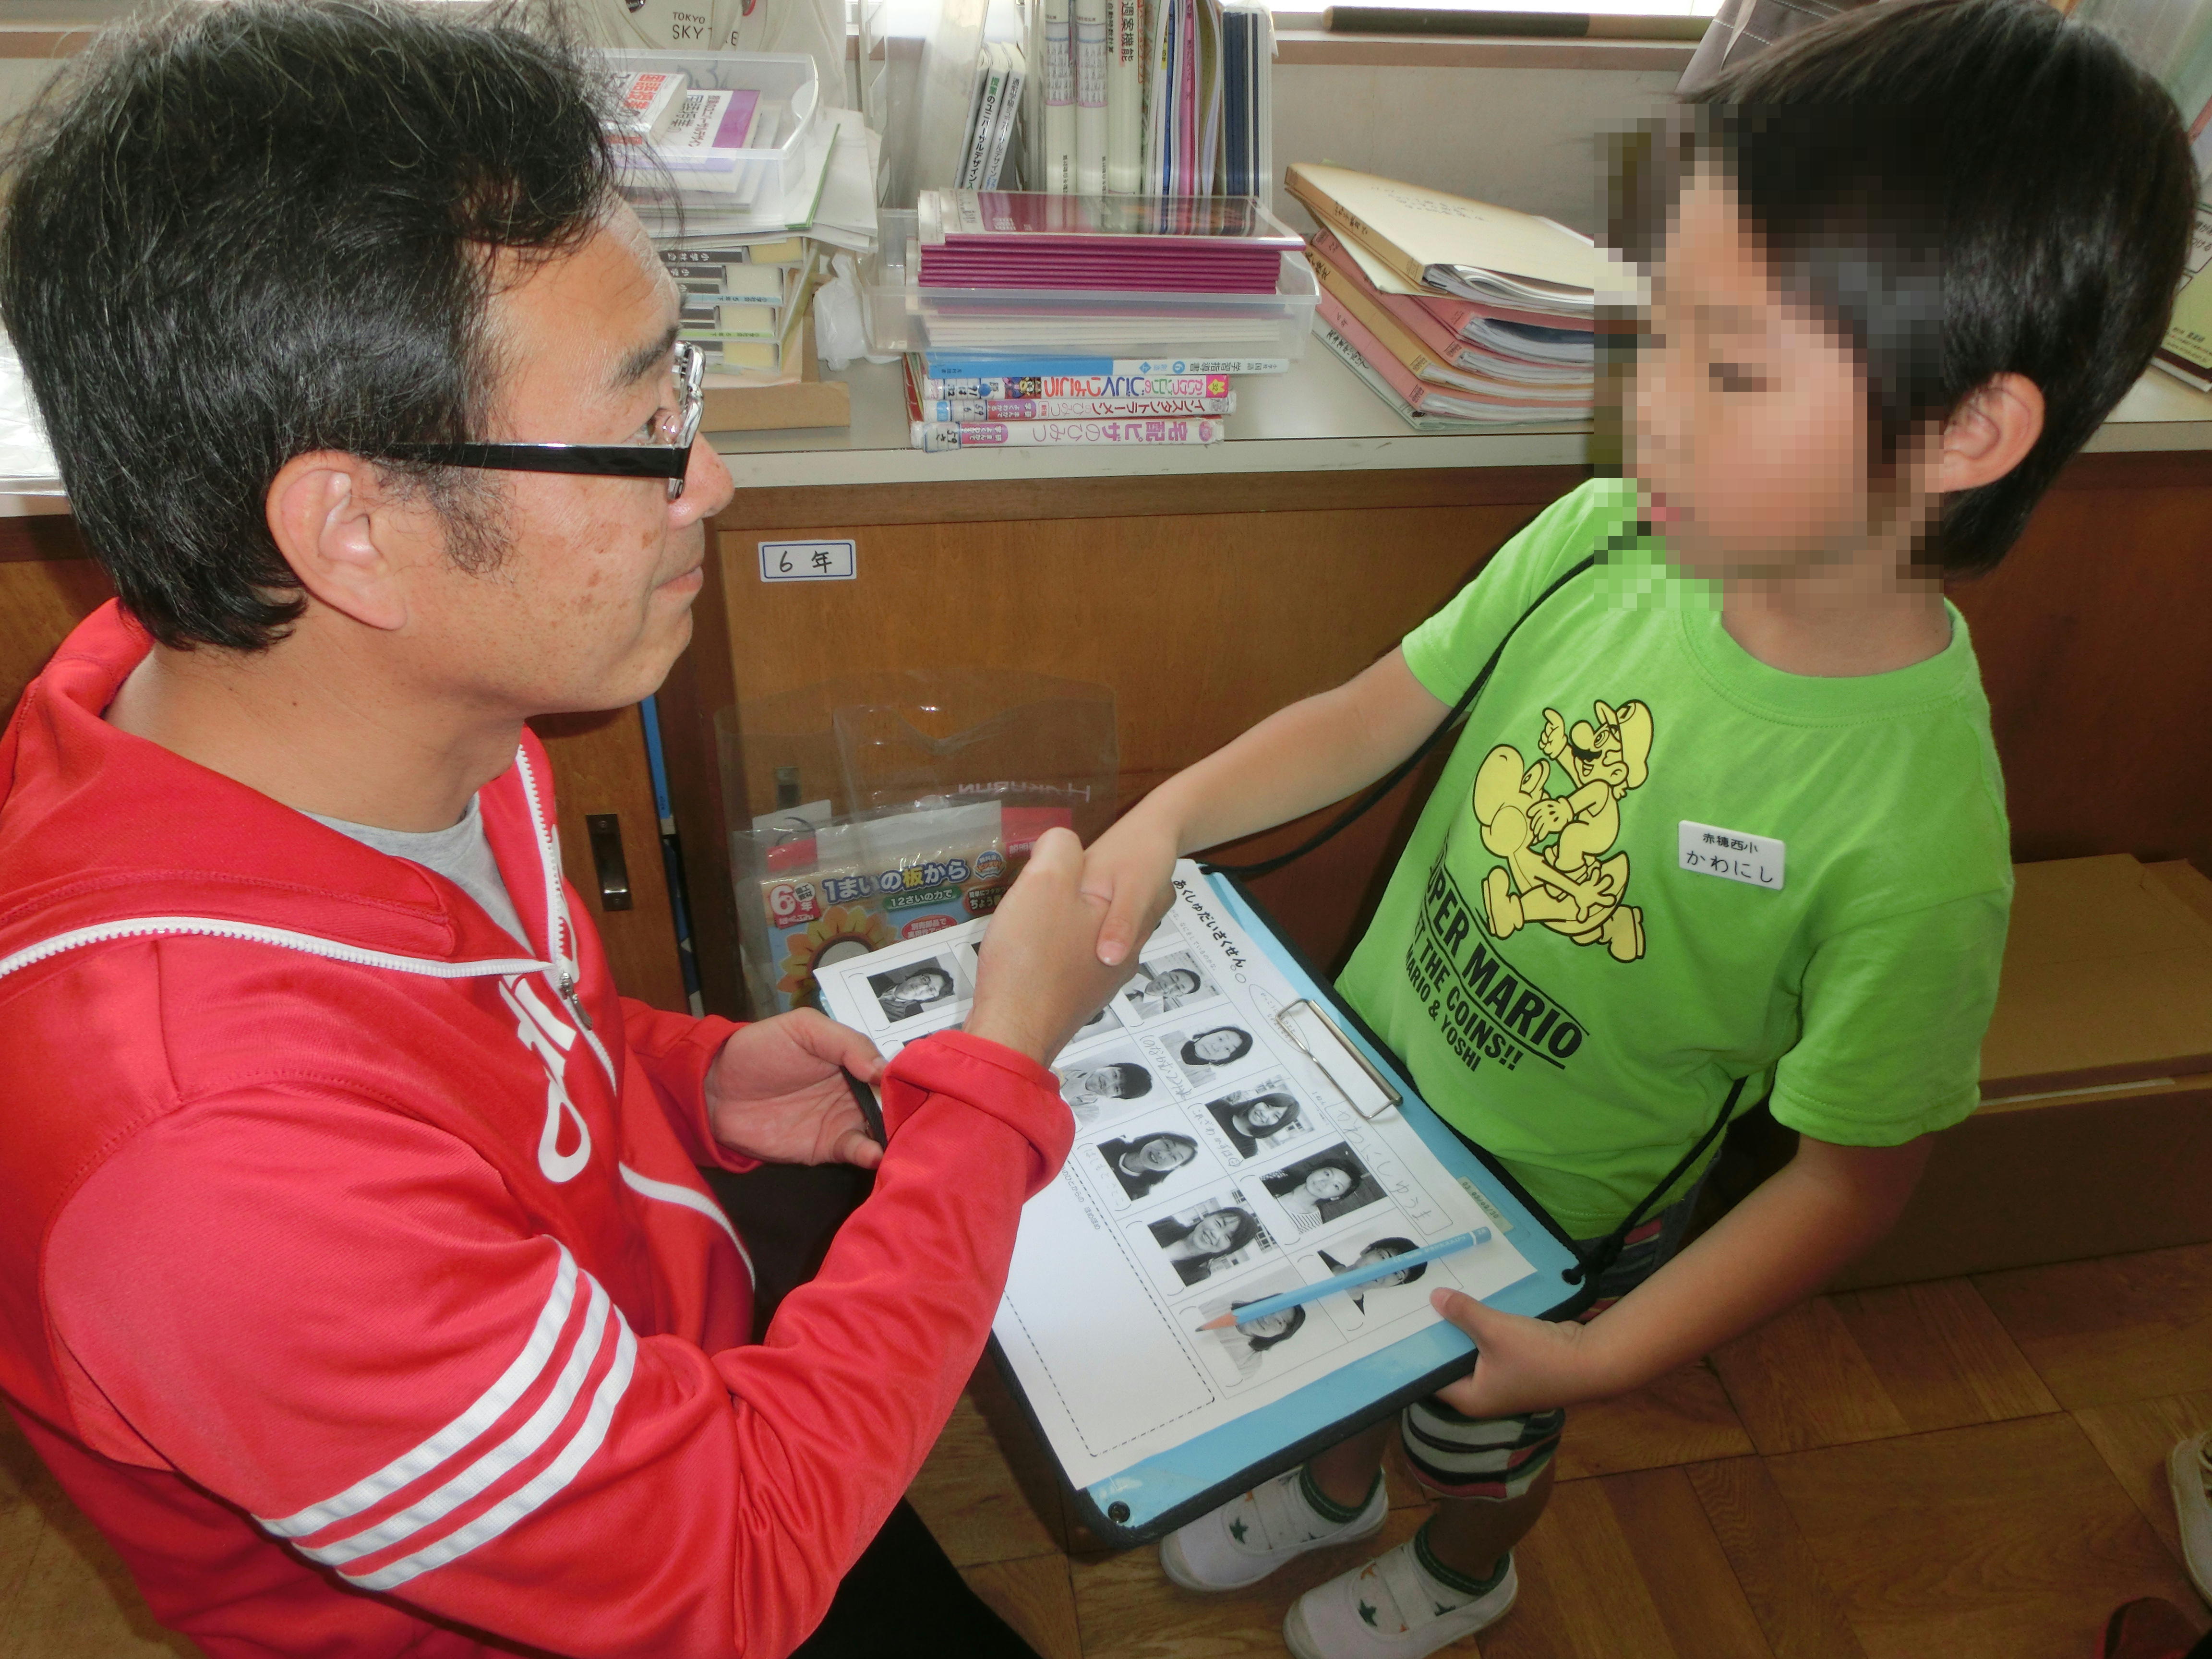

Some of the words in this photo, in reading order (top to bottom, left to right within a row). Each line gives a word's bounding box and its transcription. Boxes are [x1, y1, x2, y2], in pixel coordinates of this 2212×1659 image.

[673, 12, 705, 24] TOKYO
[673, 24, 704, 39] SKY
[1121, 2, 1134, 62] 週案機能
[1190, 361, 1241, 372] 学習指導書
[1212, 383, 1218, 391] 32
[1050, 400, 1205, 417] インスタントラーメンのひみつ
[1033, 421, 1188, 442] 宅配ピザのひみつ
[780, 550, 793, 573] 6
[811, 550, 833, 574] 年
[1703, 833, 1758, 854] 赤穂西小
[1686, 850, 1773, 883] かわにし
[823, 860, 967, 902] 1まいの板から
[890, 889, 953, 907] 12さいの力で
[1173, 879, 1247, 968] あくしゅだいさくせん
[1419, 938, 1450, 993] THE
[1446, 986, 1524, 1070] COINS!!
[1462, 942, 1583, 1058] MARIO
[1428, 1000, 1441, 1021] &
[1440, 1014, 1482, 1072] YOSHI
[1084, 1206, 1101, 1230] ほめほめ
